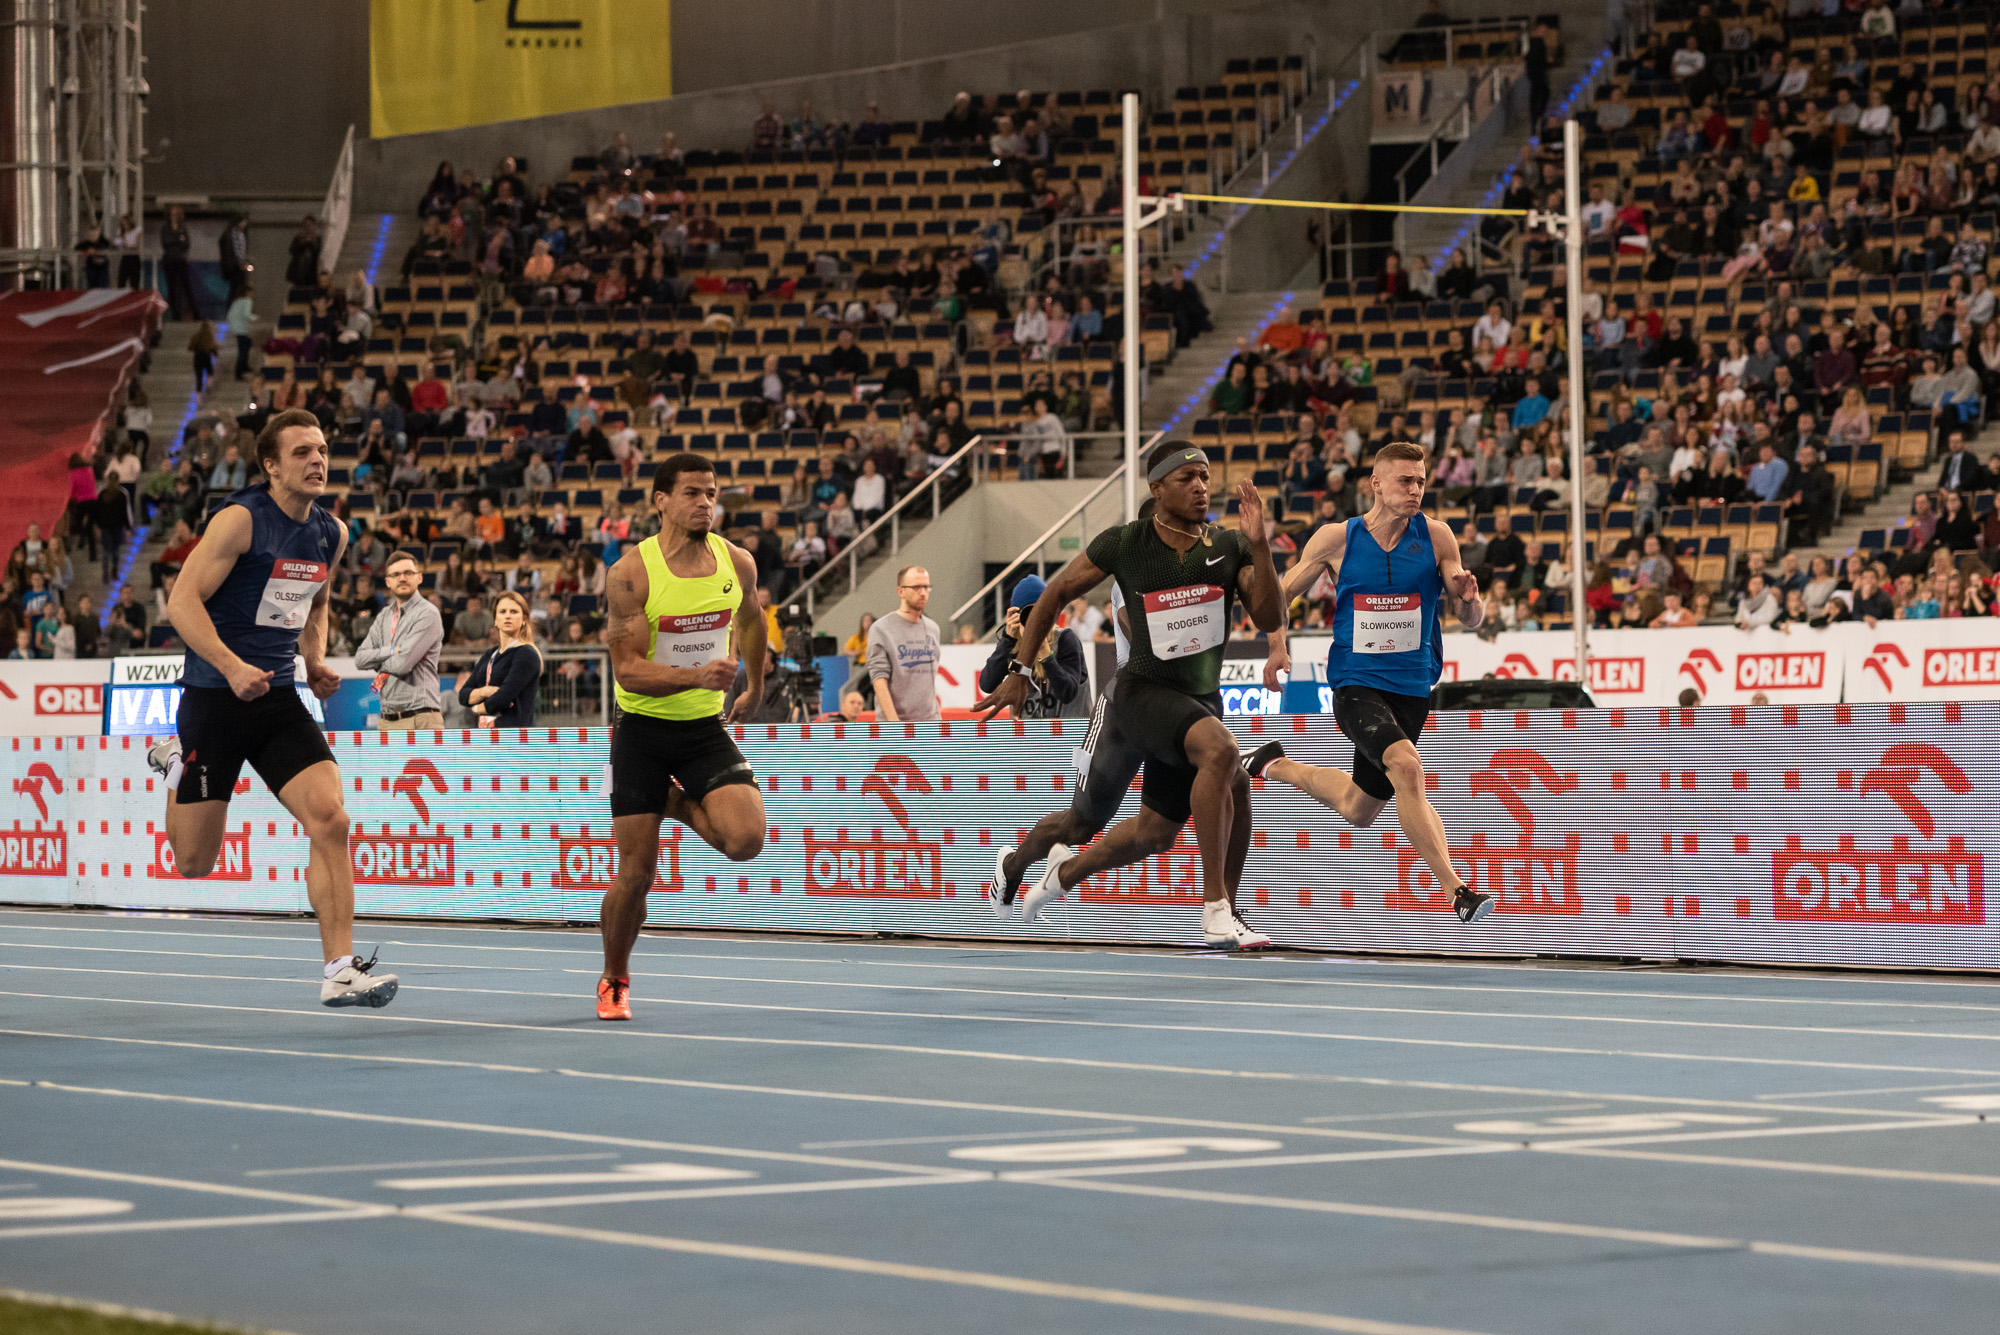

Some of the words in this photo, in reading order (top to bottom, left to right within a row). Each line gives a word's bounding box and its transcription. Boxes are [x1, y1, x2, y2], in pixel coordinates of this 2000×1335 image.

[282, 563, 306, 572] ORLEN
[306, 565, 319, 573] CUP
[1158, 590, 1191, 602] ORLEN
[1191, 586, 1209, 598] CUP
[674, 616, 704, 626] ORLEN
[704, 614, 720, 622] CUP
[1167, 615, 1209, 631] RODGERS
[1360, 621, 1414, 629] SŁOWIKOWSKI
[672, 642, 716, 653] ROBINSON
[1739, 656, 1821, 687] ORLEN
[1926, 652, 2000, 684] ORLE
[1220, 687, 1282, 714] CCHI
[354, 842, 448, 878] ORLEN
[812, 848, 933, 890] ORLEN
[1785, 861, 1970, 913] ORLEN
